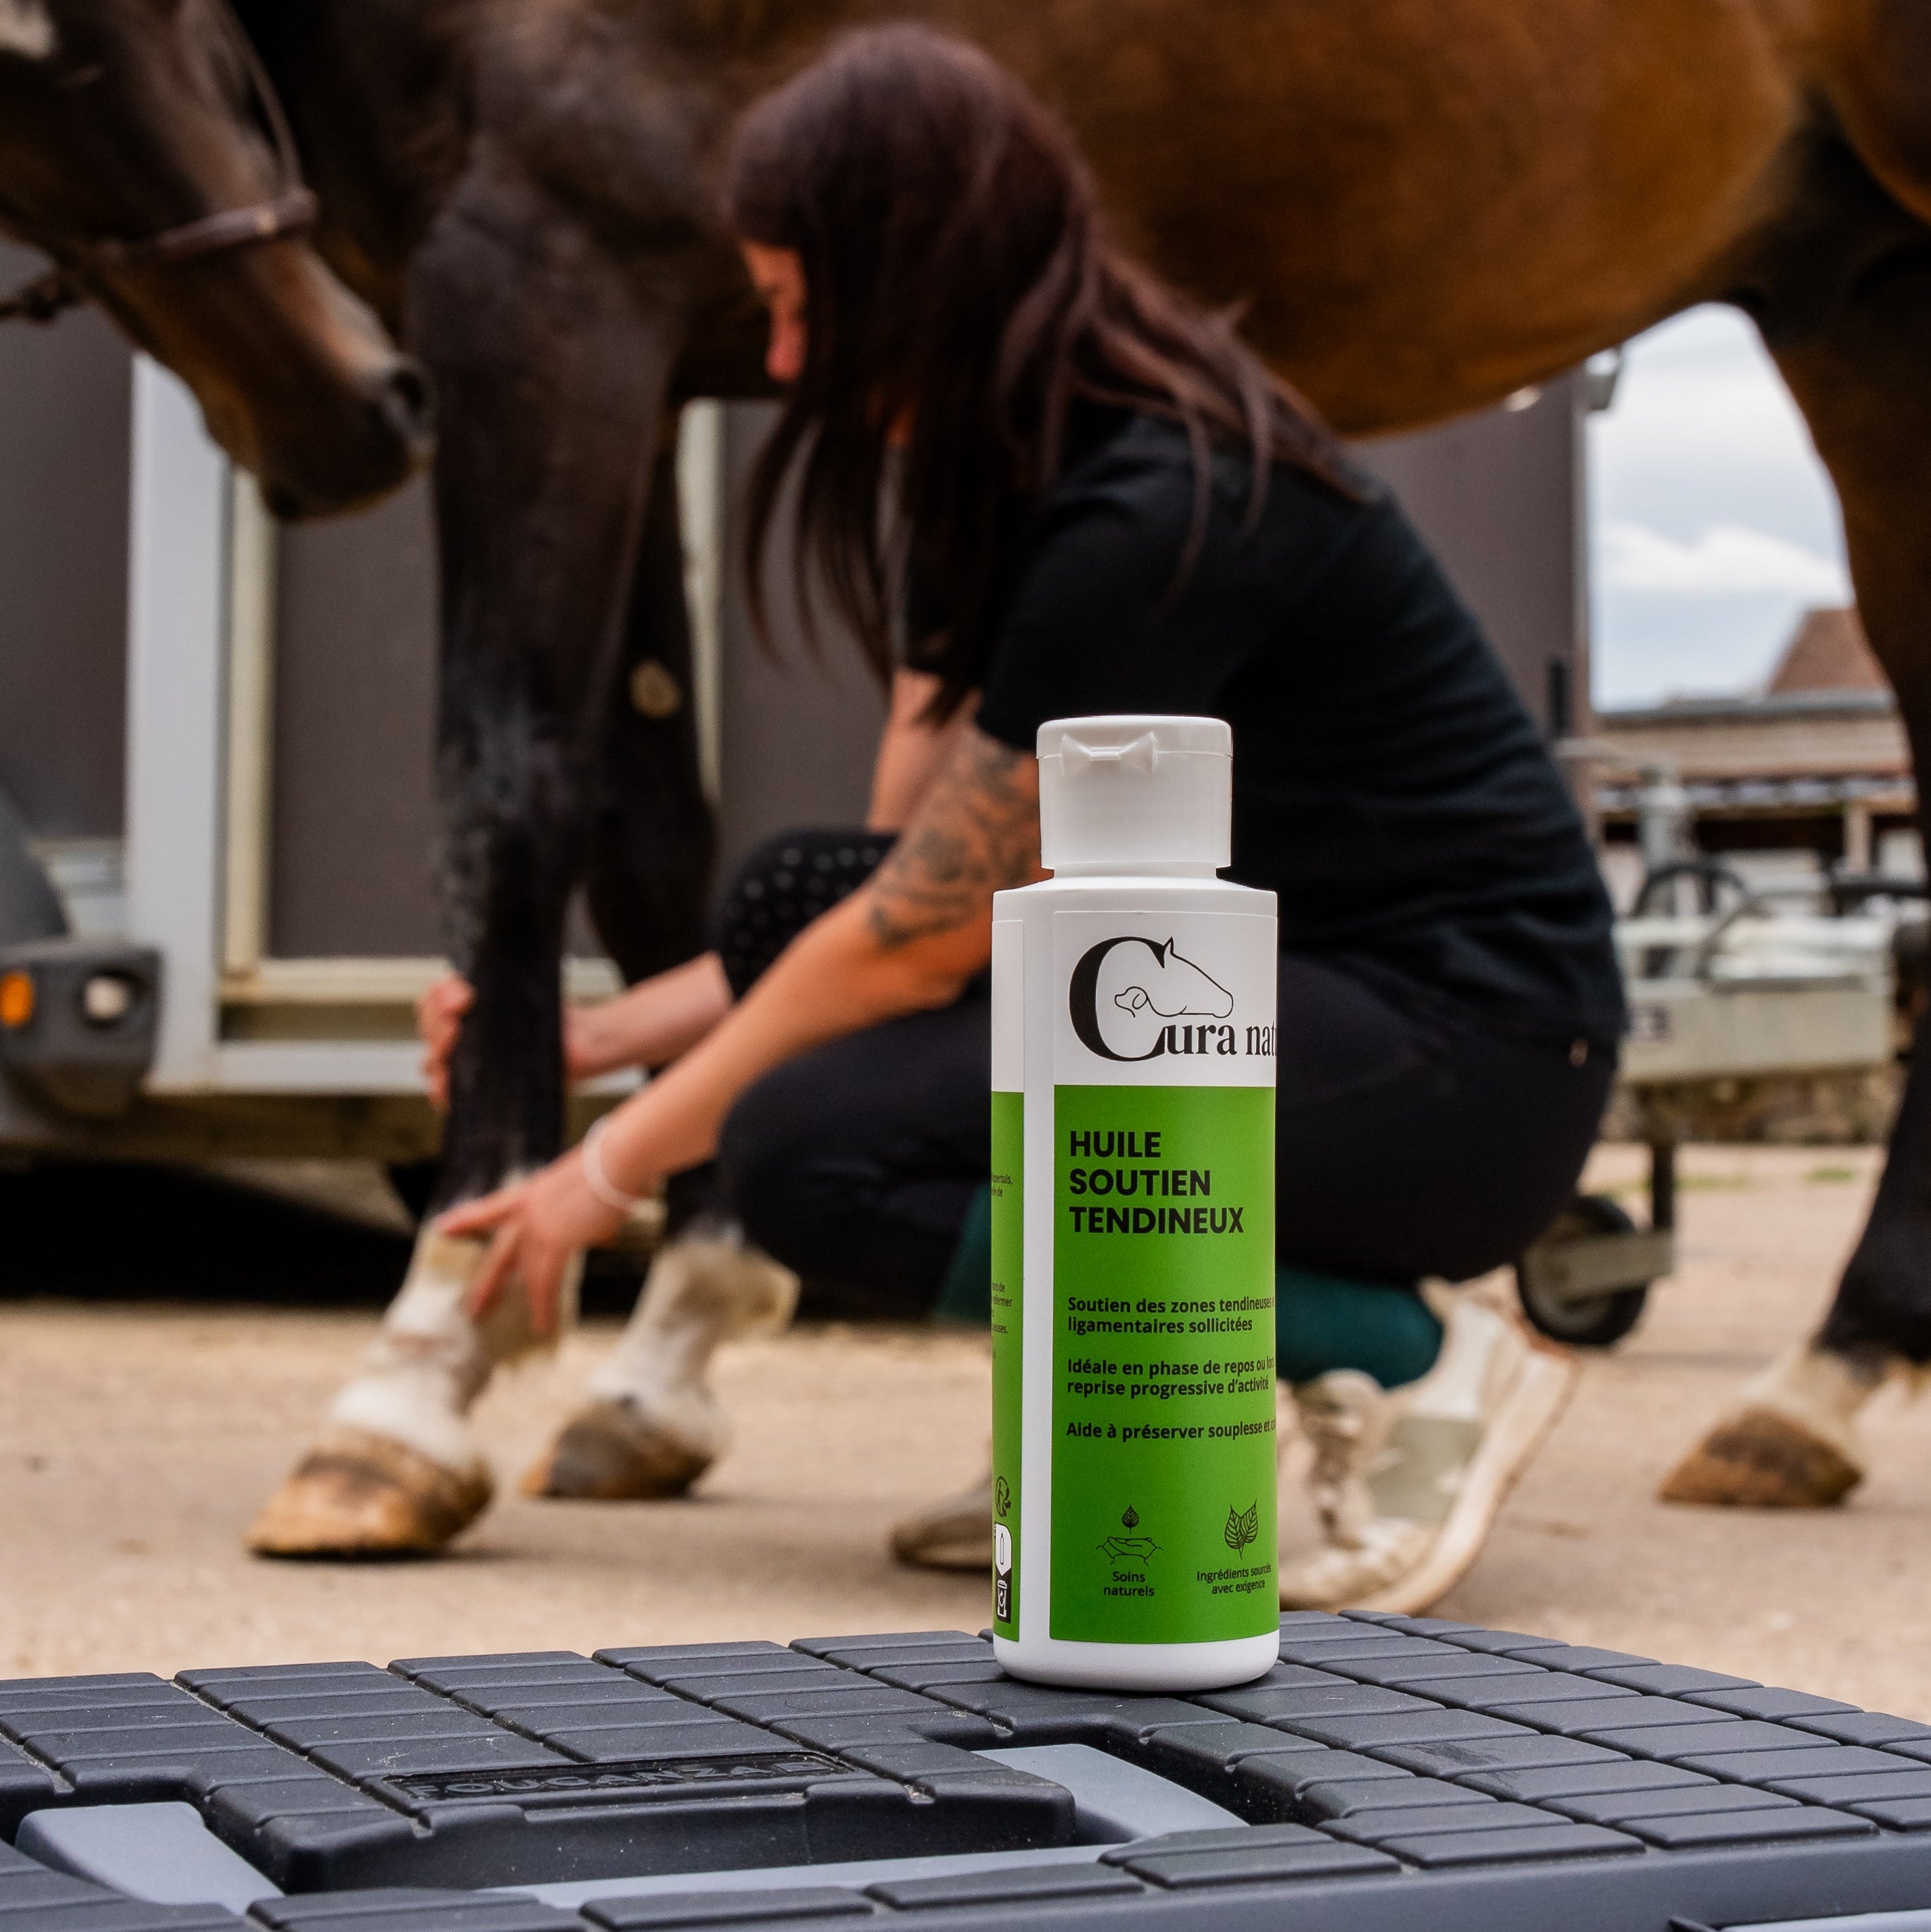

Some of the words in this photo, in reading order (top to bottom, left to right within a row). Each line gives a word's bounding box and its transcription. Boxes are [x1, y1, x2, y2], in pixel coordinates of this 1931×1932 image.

[1068, 937, 1237, 1062] Cura
[1245, 1020, 1275, 1057] nat
[1070, 1131, 1161, 1158] HUILE
[1069, 1168, 1210, 1196] SOUTIEN
[1069, 1206, 1244, 1234] TENDINEUX
[1068, 1296, 1131, 1313] Soutien
[1135, 1299, 1166, 1313] des
[1171, 1299, 1215, 1313] zones
[1219, 1296, 1272, 1311] tendineuses
[1068, 1316, 1184, 1335] ligamentaires
[1189, 1317, 1253, 1332] sollicitées
[1068, 1359, 1116, 1374] Idéale
[1122, 1362, 1143, 1375] en
[1150, 1361, 1198, 1379] phase
[1202, 1360, 1220, 1374] de
[1224, 1360, 1254, 1376] repos
[1257, 1359, 1265, 1371] ou
[1068, 1380, 1126, 1397] reprise
[1131, 1380, 1224, 1399] progressive
[1066, 1423, 1102, 1438] Aide
[1107, 1423, 1116, 1438] à
[1123, 1424, 1204, 1442] préserver
[1208, 1421, 1262, 1440] souplesse
[1112, 1571, 1145, 1582] Soins
[1197, 1567, 1249, 1584] Ingrédients
[1104, 1586, 1155, 1596] naturels
[1212, 1584, 1233, 1594] avec
[1236, 1579, 1265, 1594] exigence
[405, 1765, 776, 1799] FOUGANZA
